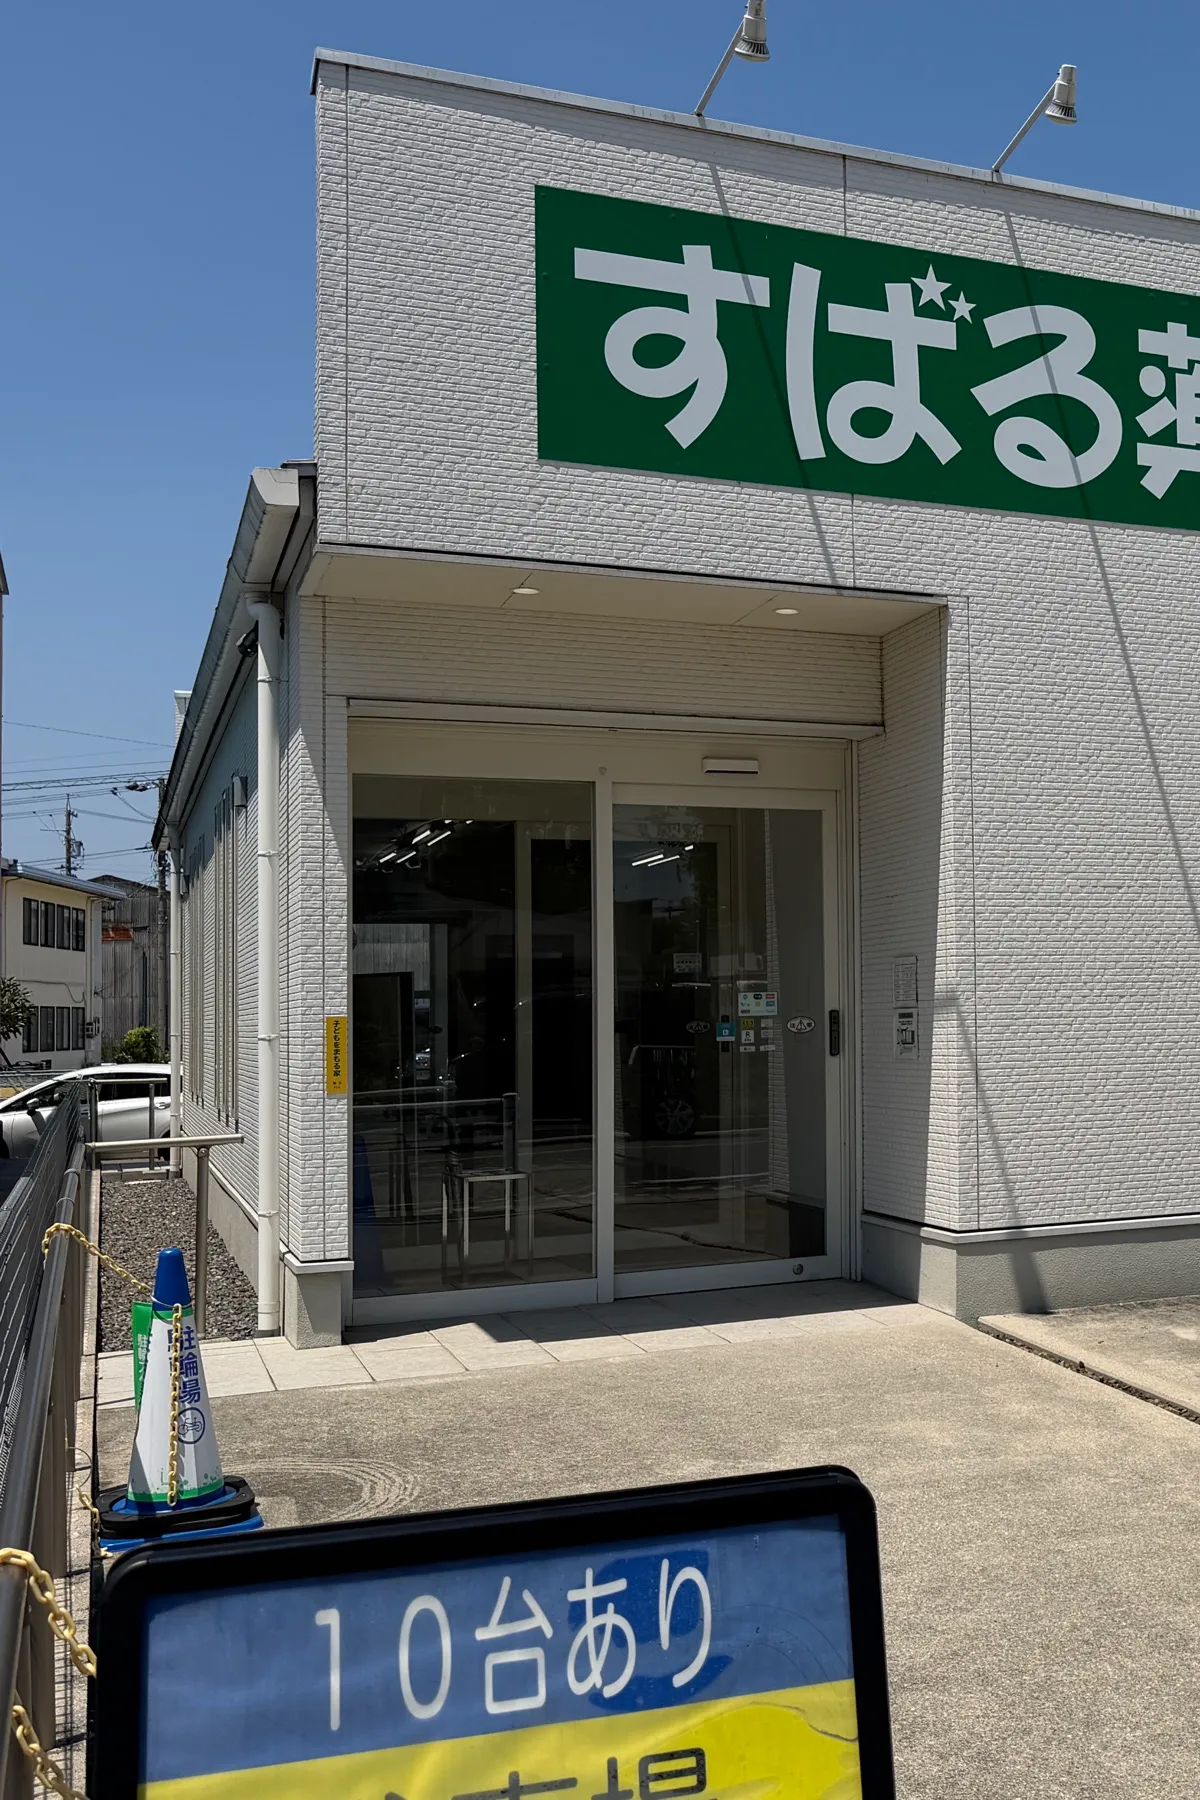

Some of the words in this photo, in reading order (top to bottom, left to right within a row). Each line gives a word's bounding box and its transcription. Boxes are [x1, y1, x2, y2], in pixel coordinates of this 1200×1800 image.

[332, 1020, 341, 1077] 子どもをまもる家
[315, 1559, 712, 1731] 10台あり
